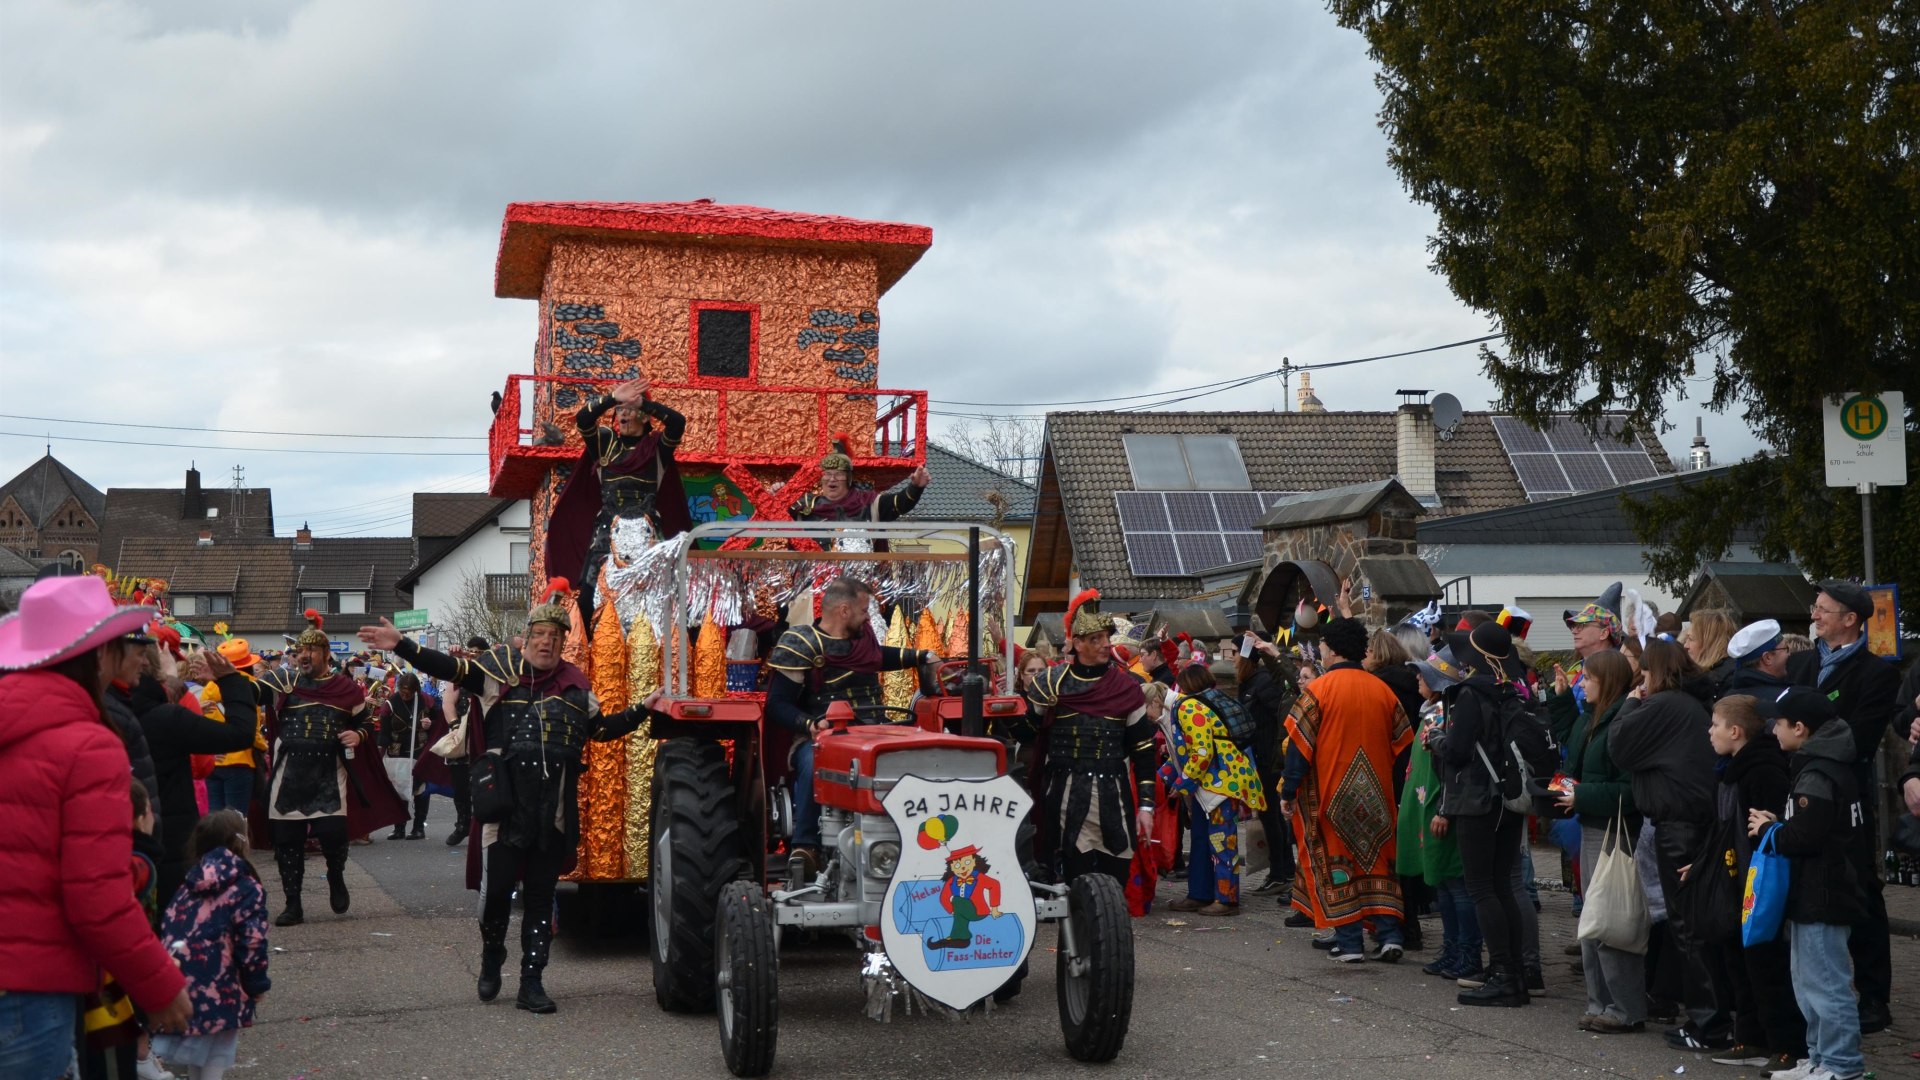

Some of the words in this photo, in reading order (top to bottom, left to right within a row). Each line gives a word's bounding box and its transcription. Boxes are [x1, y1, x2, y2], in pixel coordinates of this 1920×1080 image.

[1854, 404, 1874, 430] H
[904, 798, 928, 818] 24
[938, 793, 1019, 819] JAHRE
[975, 934, 992, 945] Die
[946, 949, 1014, 962] Fass-Nachter
